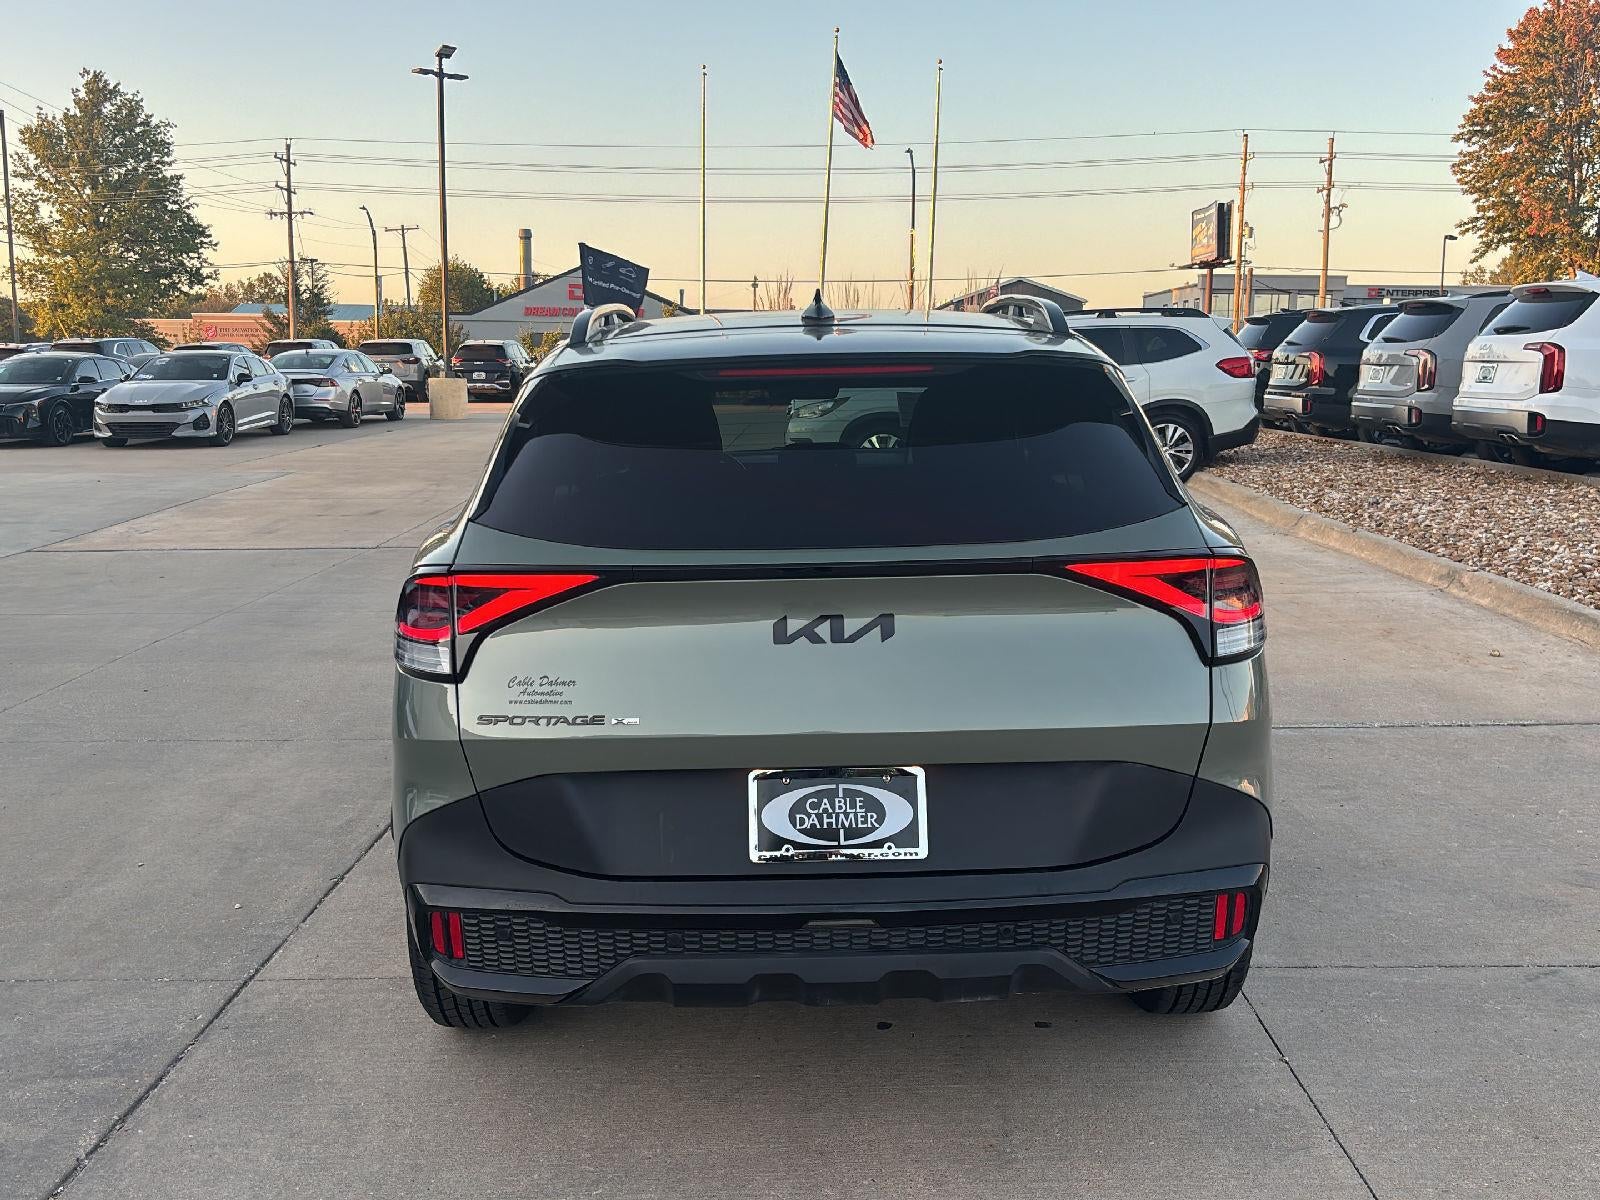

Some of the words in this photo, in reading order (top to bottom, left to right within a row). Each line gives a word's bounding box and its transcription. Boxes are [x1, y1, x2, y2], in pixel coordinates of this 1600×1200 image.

[508, 675, 535, 689] Cable
[539, 675, 577, 688] Dahmer
[517, 687, 564, 698] Automotive
[476, 714, 606, 726] SPORTAGE
[805, 797, 866, 814] CABLE
[795, 812, 881, 830] DAHMER
